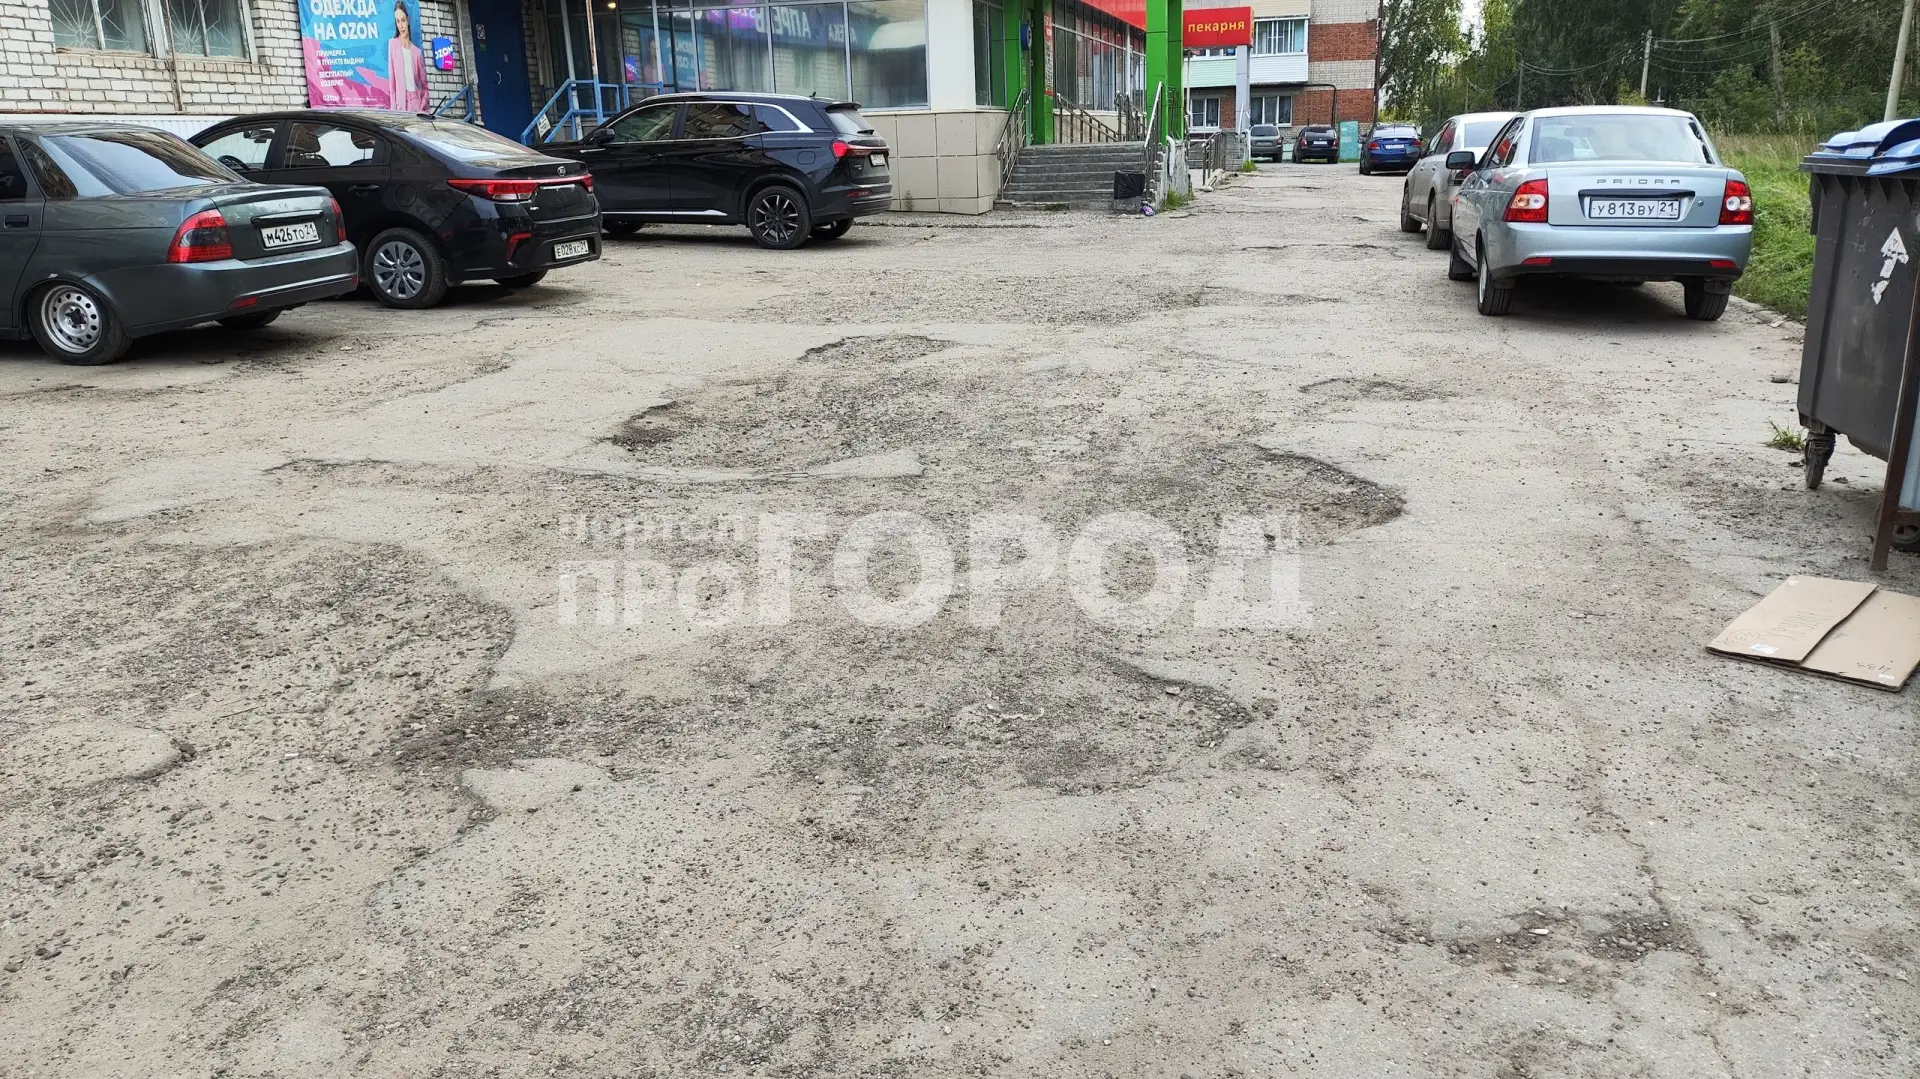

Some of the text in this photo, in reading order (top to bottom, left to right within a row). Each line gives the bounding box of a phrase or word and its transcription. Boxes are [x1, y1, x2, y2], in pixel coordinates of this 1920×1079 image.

[311, 0, 377, 18] ОДЕЖДА
[314, 22, 379, 40] НА OZON
[1188, 21, 1245, 34] пекарня
